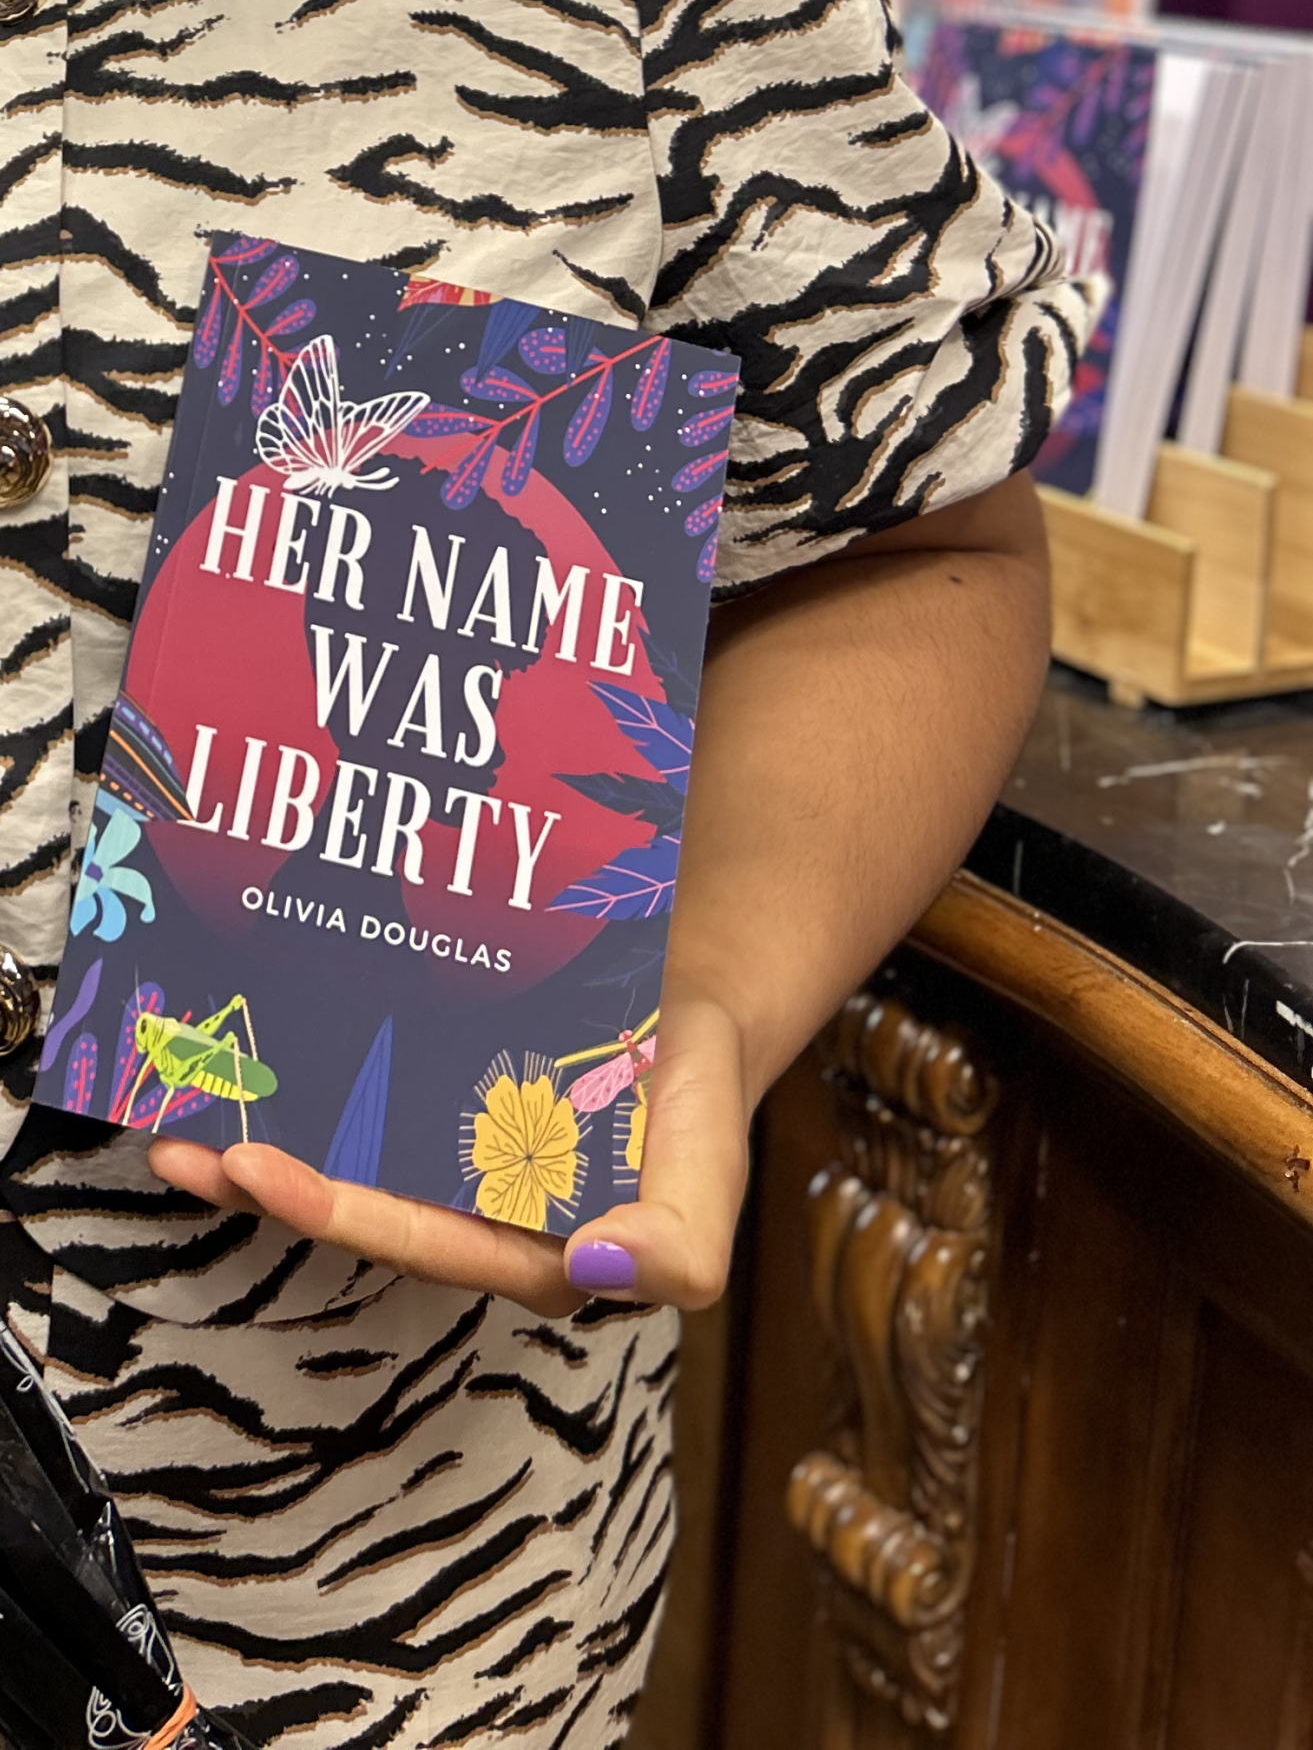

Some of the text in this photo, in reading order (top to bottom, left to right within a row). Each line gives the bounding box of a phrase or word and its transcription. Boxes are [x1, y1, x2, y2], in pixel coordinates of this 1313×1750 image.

[199, 476, 644, 677] HER NAME
[310, 624, 504, 768] WAS
[176, 724, 561, 911] LIBERTY
[241, 886, 512, 973] OLIVIA DOUGLAS
